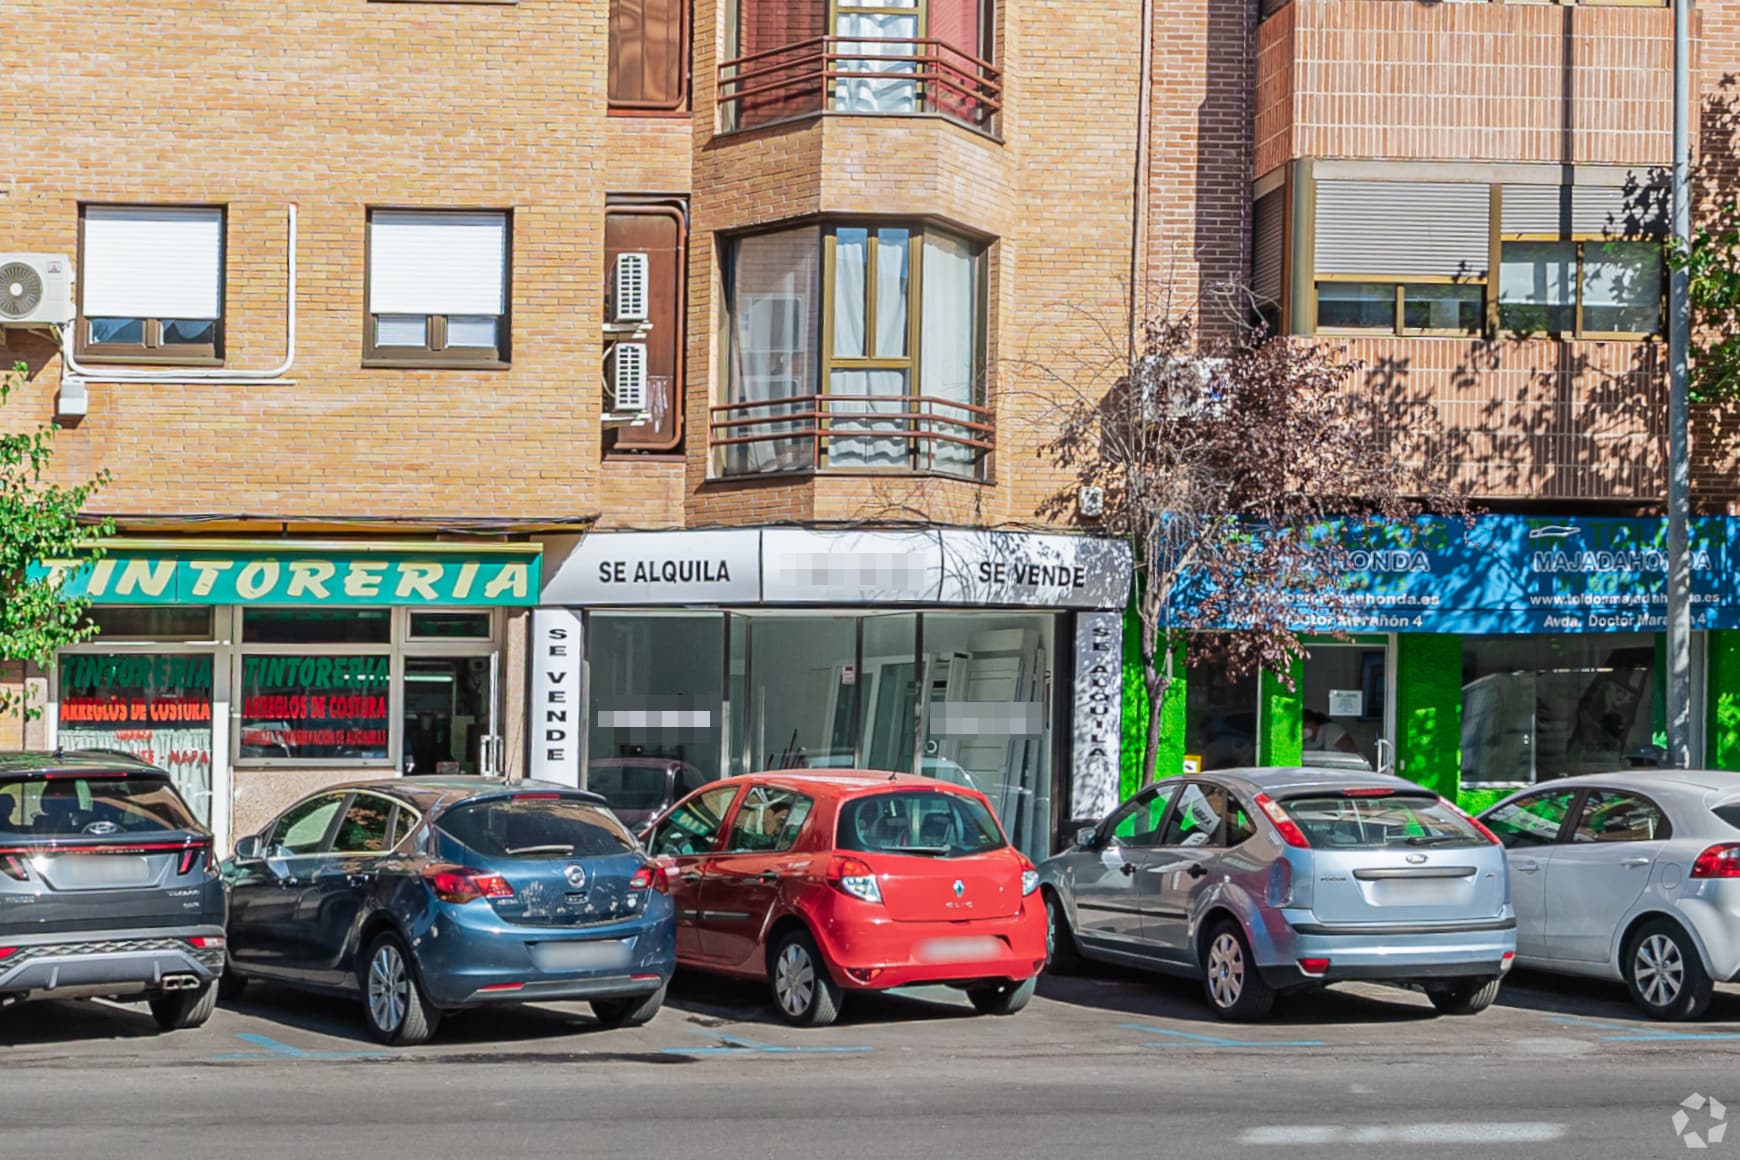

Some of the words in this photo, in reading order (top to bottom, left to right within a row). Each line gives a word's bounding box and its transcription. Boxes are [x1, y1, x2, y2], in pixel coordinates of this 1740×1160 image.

[41, 557, 528, 600] TINTORERIA
[599, 561, 627, 583] SE
[633, 560, 731, 584] ALQUILA
[978, 562, 1006, 584] SE
[1014, 563, 1086, 588] VENDE
[1412, 615, 1424, 628] 4
[1543, 614, 1582, 628] Avda.
[1588, 613, 1636, 627] Doctor
[548, 628, 568, 657] SE
[60, 656, 211, 688] TINTORERIA
[243, 657, 389, 689] TINTORERIA
[328, 696, 387, 719] COSTURA
[545, 671, 568, 761] VENDE
